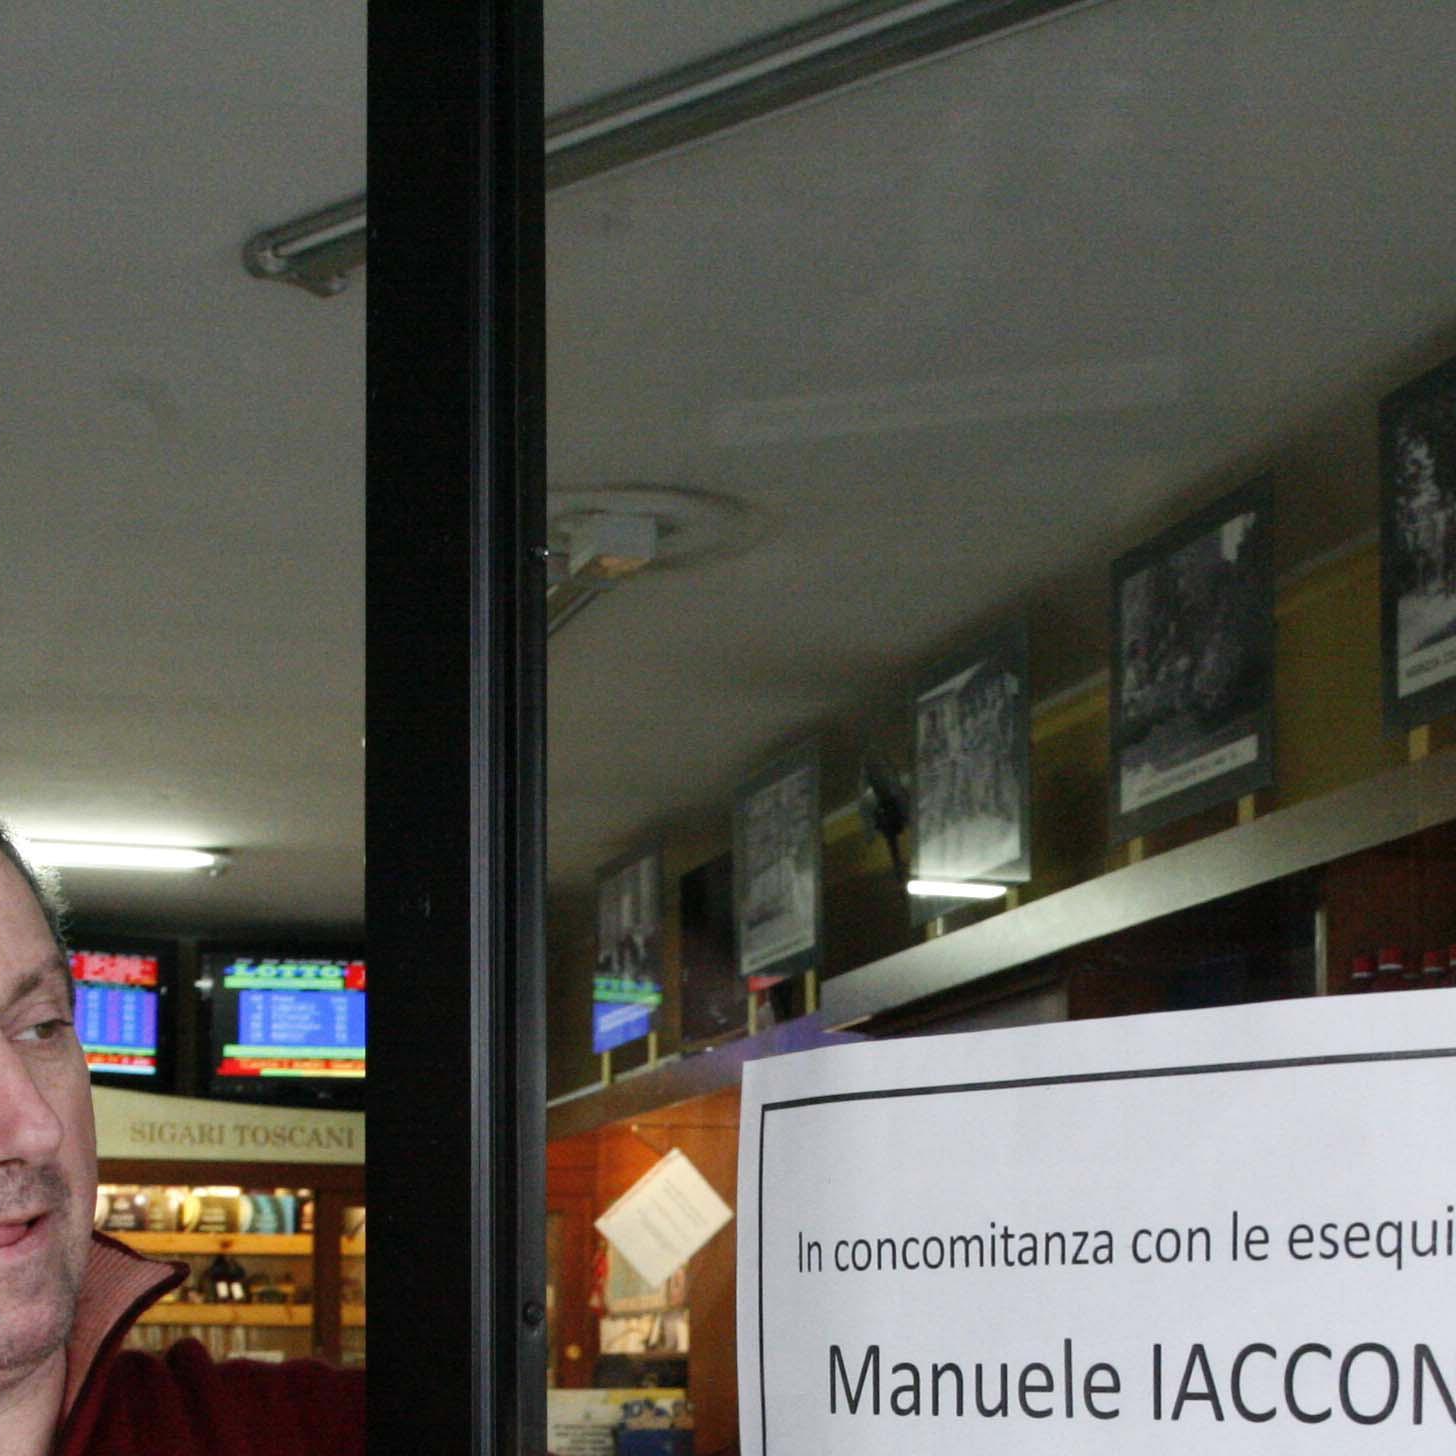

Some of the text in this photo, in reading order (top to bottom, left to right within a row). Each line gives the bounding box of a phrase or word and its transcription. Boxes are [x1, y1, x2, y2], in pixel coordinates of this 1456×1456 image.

[129, 1121, 356, 1150] SIGARI TOSCANI
[798, 1231, 823, 1273] In
[834, 1221, 1114, 1272] concomitanza
[1131, 1227, 1211, 1264] con
[1232, 1210, 1270, 1261] le
[829, 1338, 1121, 1420] Manuele
